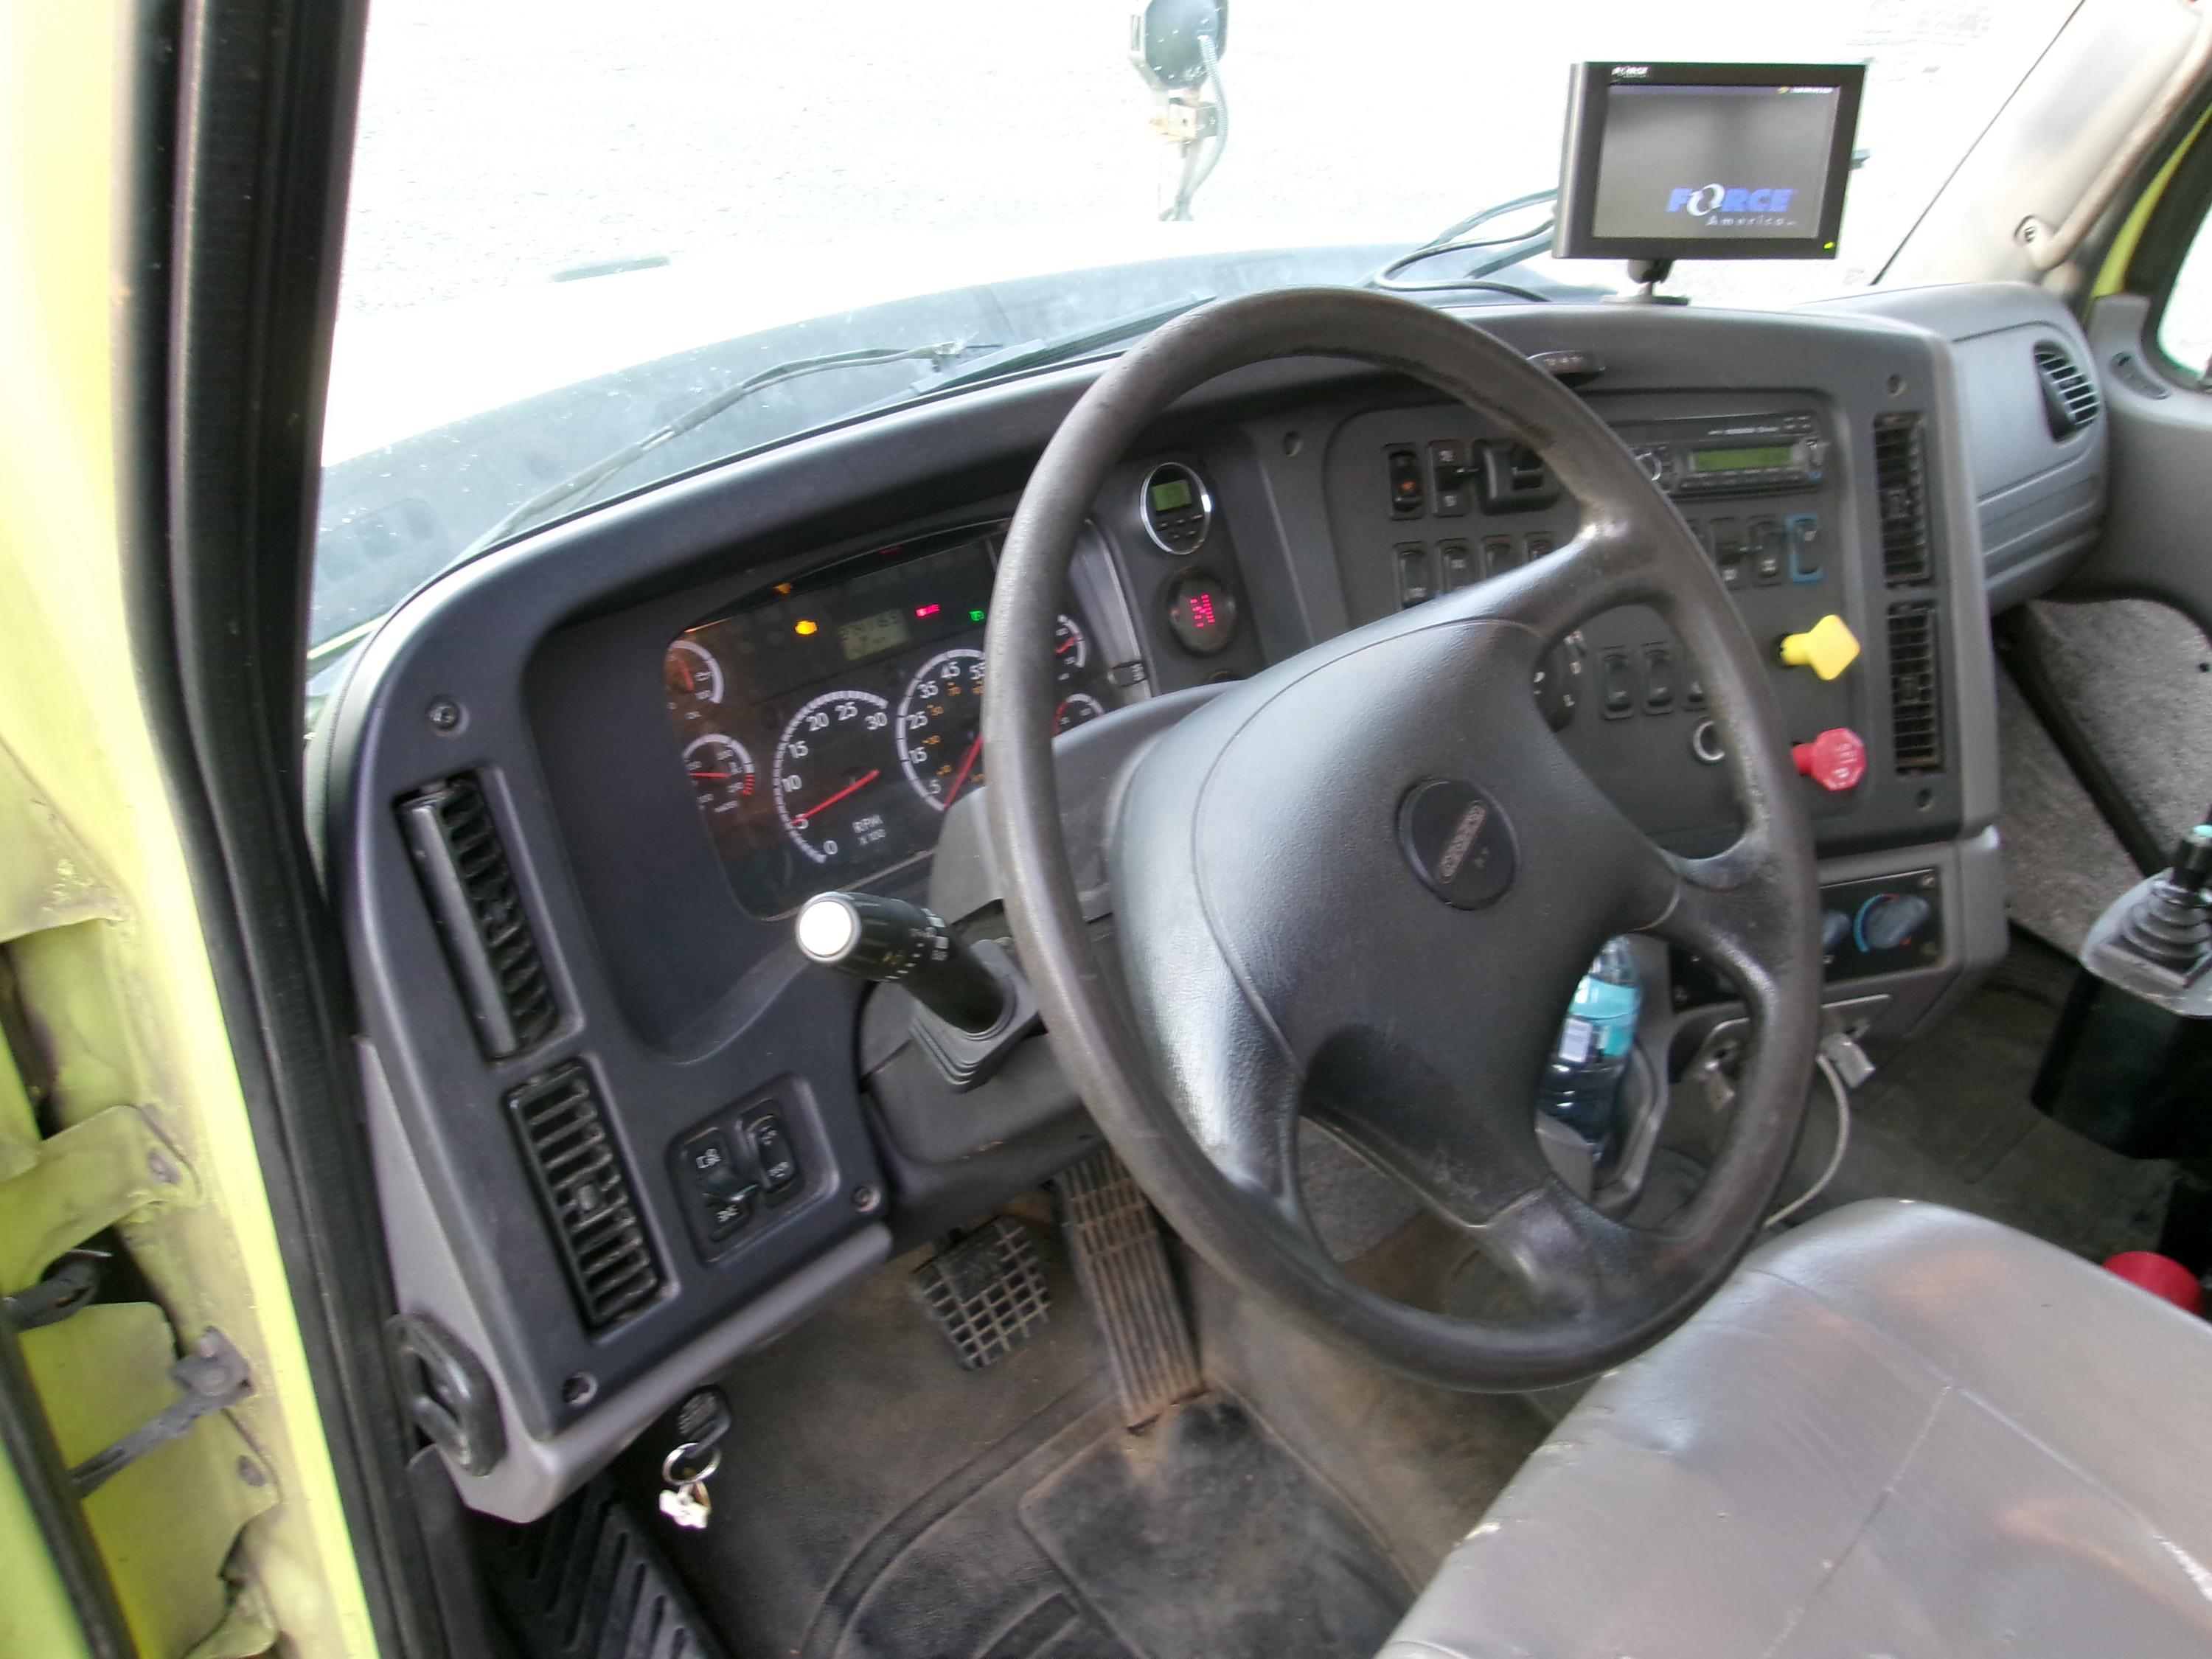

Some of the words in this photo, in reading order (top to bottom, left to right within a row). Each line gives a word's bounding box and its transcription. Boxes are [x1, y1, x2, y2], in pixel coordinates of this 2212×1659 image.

[1665, 184, 1795, 216] FORCE
[941, 661, 961, 679] 45
[917, 681, 939, 699] 35
[835, 702, 858, 721] 25
[905, 711, 928, 730] 25
[806, 712, 830, 731] 20
[865, 712, 888, 730] 30
[789, 740, 809, 759] 15
[908, 747, 928, 764] 15
[782, 774, 802, 793] 10
[930, 779, 942, 795] 5
[823, 840, 838, 855] 0
